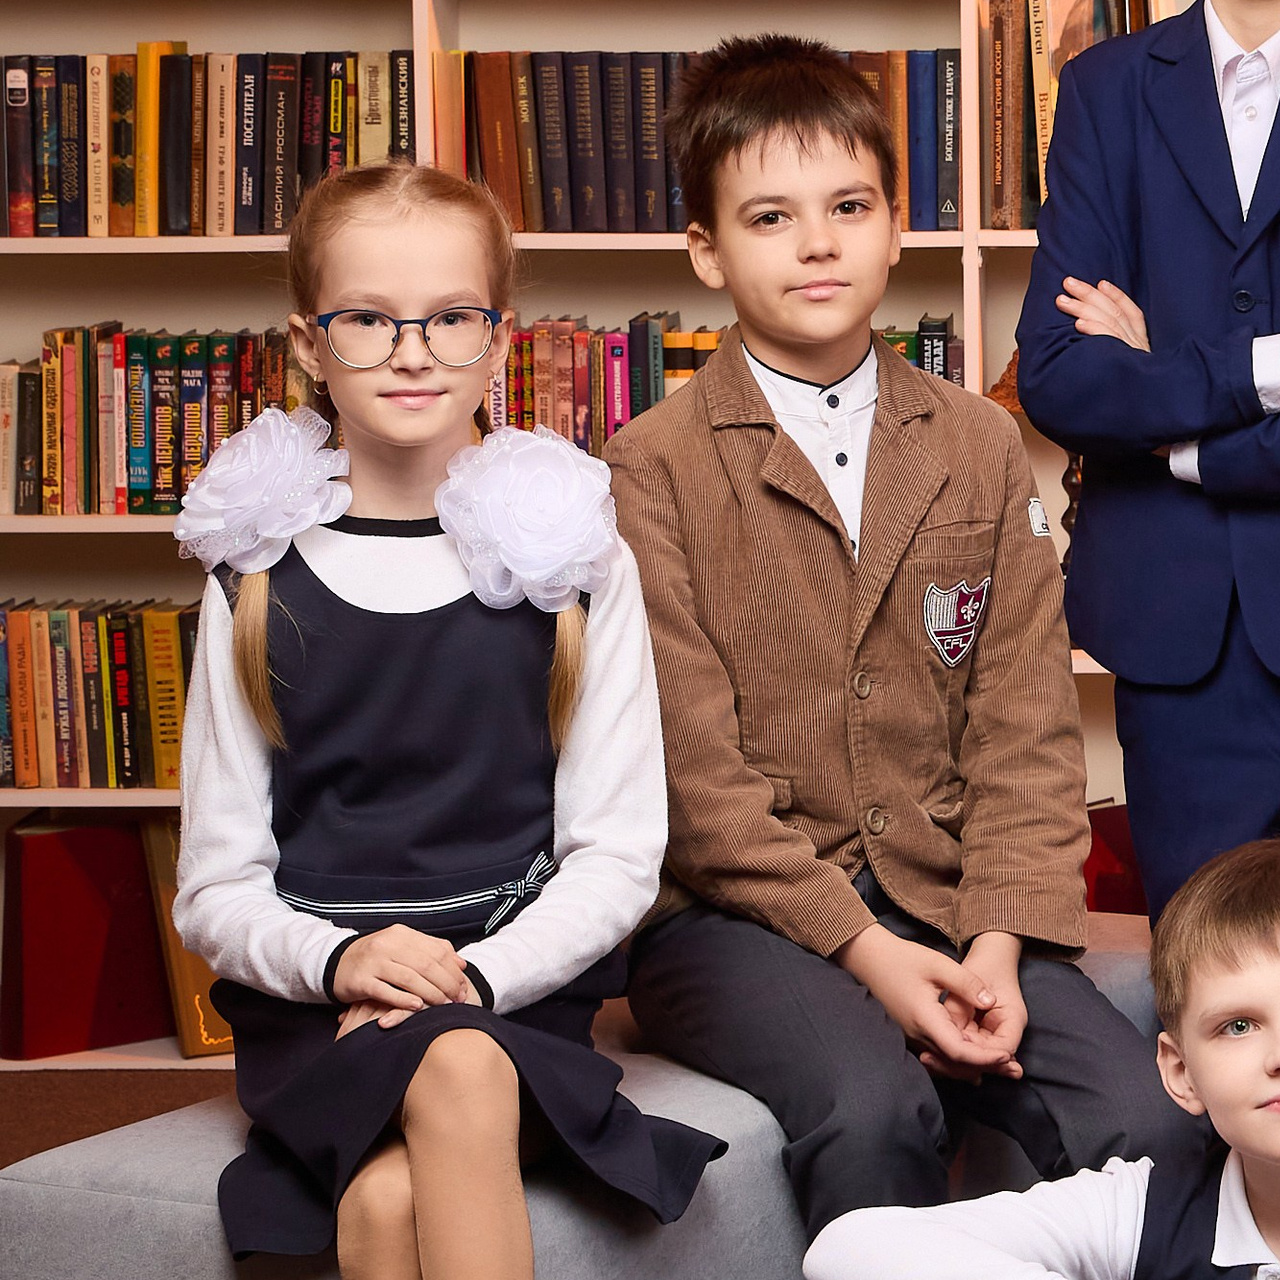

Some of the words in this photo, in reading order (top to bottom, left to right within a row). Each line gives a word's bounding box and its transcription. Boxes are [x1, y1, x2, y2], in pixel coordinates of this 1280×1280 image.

[994, 39, 1002, 69] РОССИИ
[1033, 19, 1043, 56] Гоген
[364, 65, 382, 126] Крестоносцы
[518, 75, 528, 97] ВЕК
[944, 59, 954, 99] ПЛАЧУТ
[994, 77, 1002, 118] ИСТОРИЯ
[242, 74, 254, 146] ПОСЕТИТЕЛИ
[274, 91, 285, 162] ГРОССМАН
[397, 57, 409, 149] Ф.НЕЗНАНСКИЙ
[520, 100, 530, 124] МОЙ
[944, 102, 953, 125] ТОЖЕ
[944, 126, 953, 162] БОГАТЫЕ
[994, 118, 1002, 185] ПРАВОСЛАВНАЯ
[274, 164, 285, 229] ВАСИЛИЙ
[614, 360, 622, 420] ОБЩЕСТВОЗНАНИЕ
[131, 389, 146, 449] ПЕРУМОВ
[155, 405, 173, 464] ПЕРУМОВ
[184, 402, 202, 462] ПЕРУМОВ
[943, 637, 968, 651] CFL
[17, 672, 28, 708] СЛАВЫ
[55, 646, 68, 700] ЛЮБОВНИКИ
[58, 710, 70, 740] МУЖЬЯ
